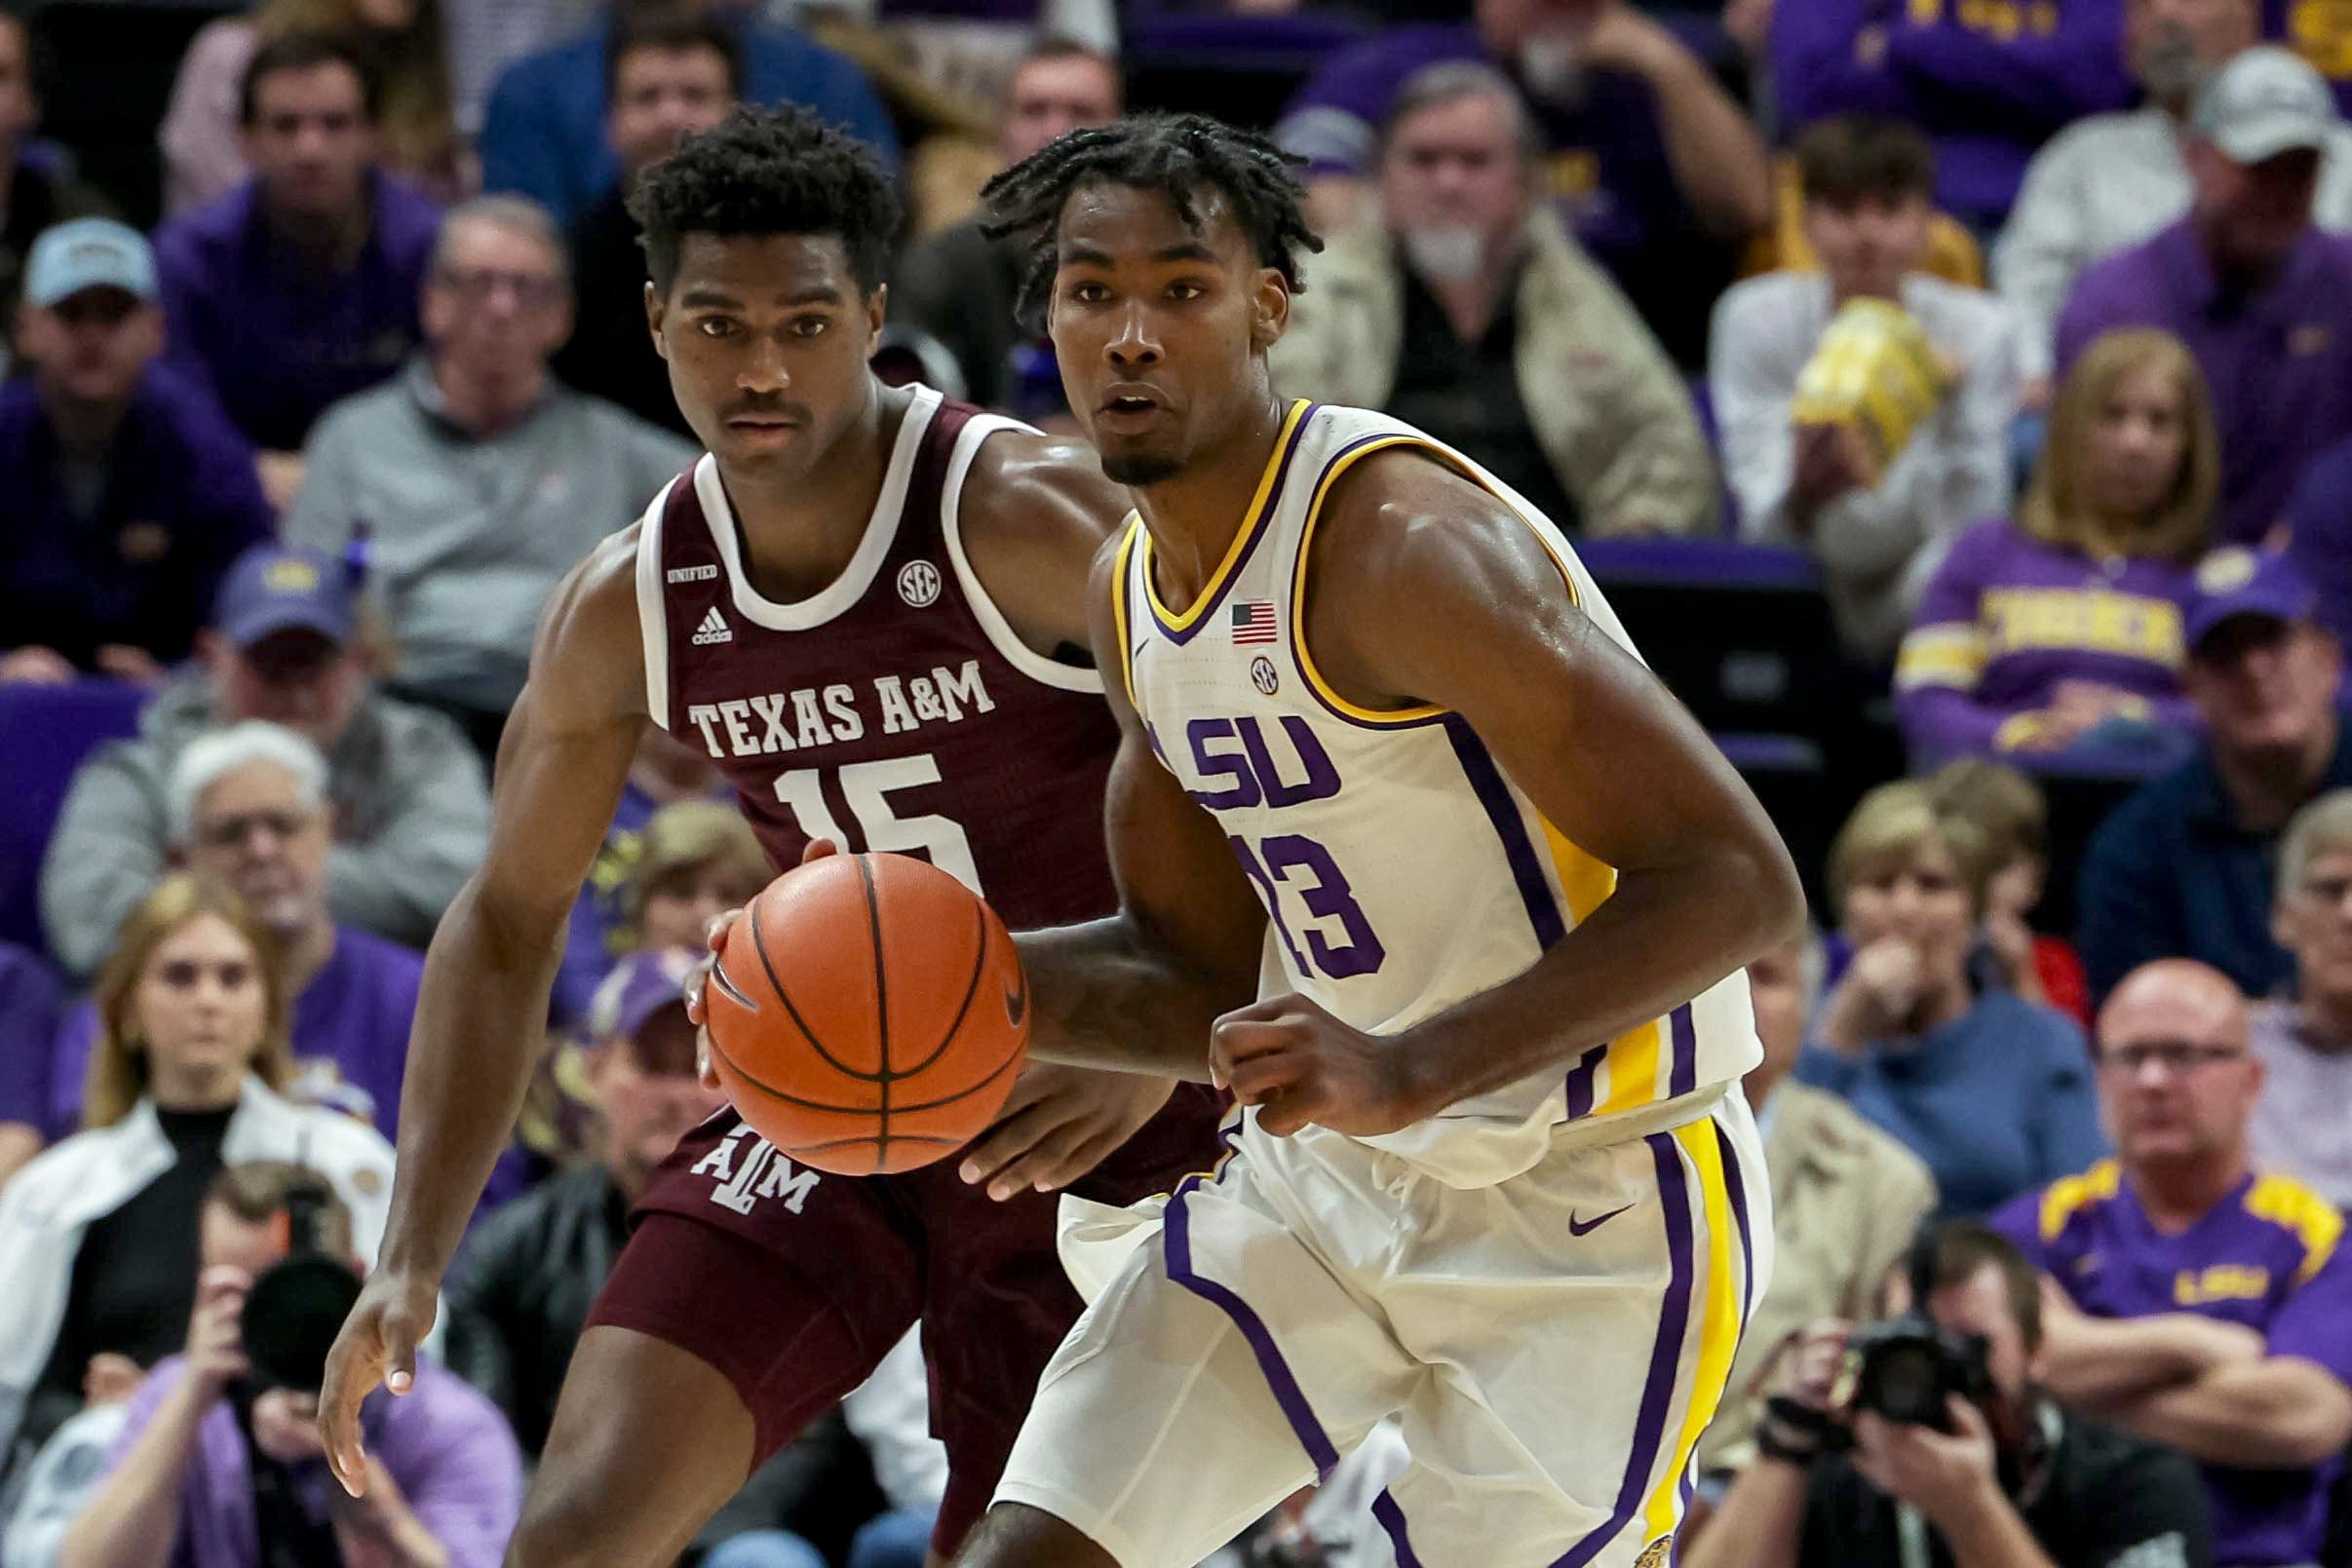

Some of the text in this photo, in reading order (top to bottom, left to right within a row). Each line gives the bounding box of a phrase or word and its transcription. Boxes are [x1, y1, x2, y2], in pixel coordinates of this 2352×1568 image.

[668, 565, 717, 584] UNIFIED
[900, 562, 939, 605] SEC
[691, 631, 733, 645] adidas
[688, 660, 997, 758] TEXAS A&M
[1148, 714, 1342, 811] SU
[773, 752, 984, 899] 15
